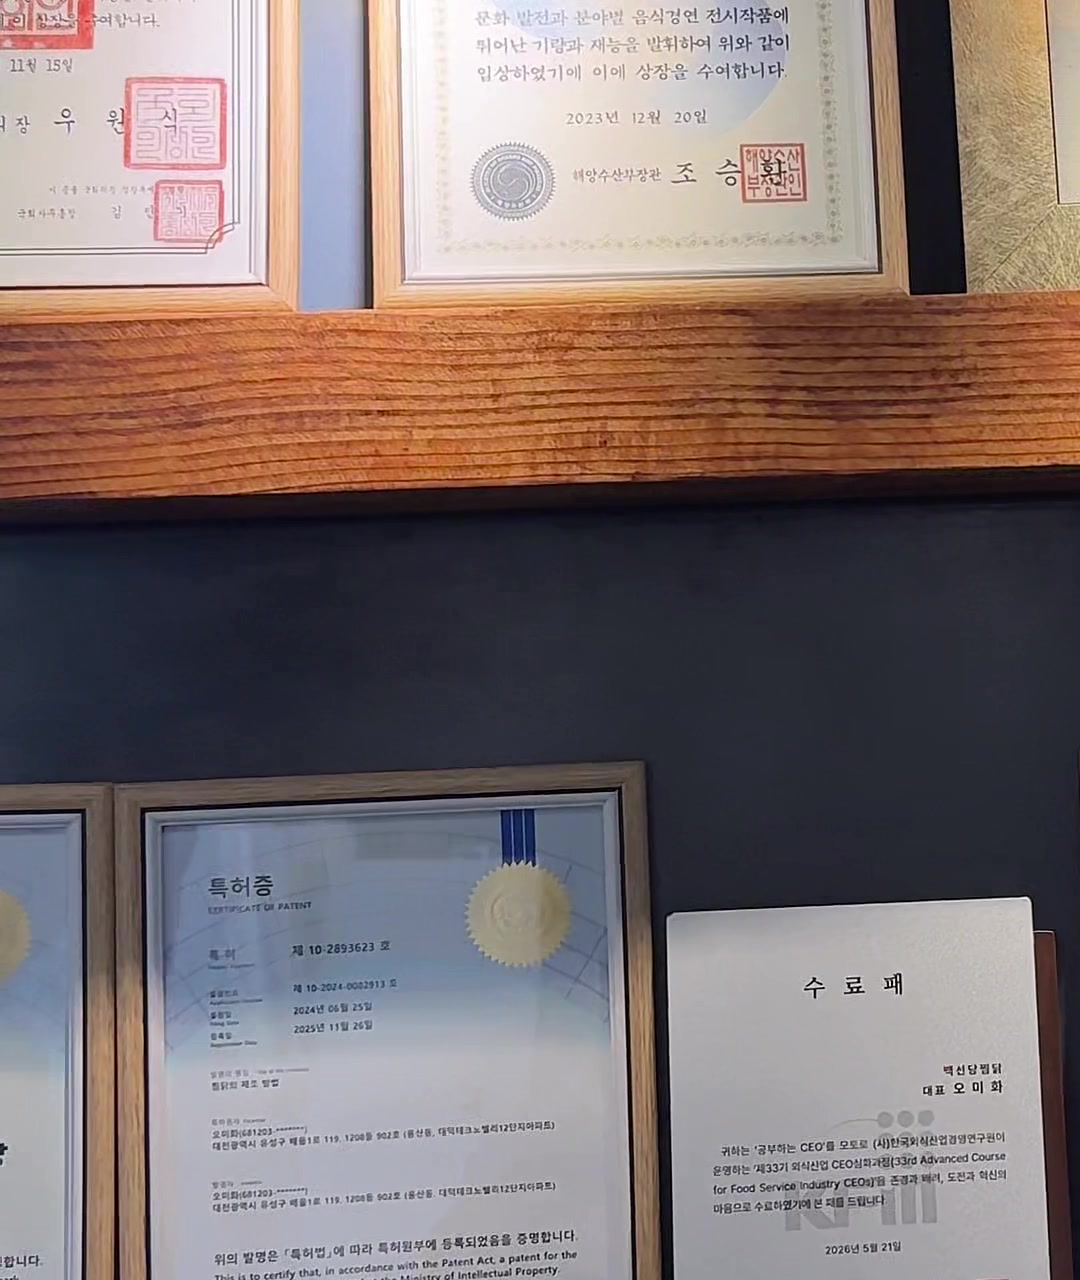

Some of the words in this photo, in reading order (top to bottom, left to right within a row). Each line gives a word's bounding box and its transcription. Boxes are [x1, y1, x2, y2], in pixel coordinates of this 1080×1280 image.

[474, 9, 510, 27] 문화
[517, 9, 568, 27] 발전과
[632, 8, 698, 26] 음식경연
[705, 6, 789, 25] 전시작품에
[476, 37, 527, 55] 뛰어난
[647, 35, 711, 53] 발휘하여
[719, 35, 752, 52] 위와
[758, 34, 790, 52] 같이
[477, 64, 582, 82] 입상하였기에
[592, 64, 626, 81] 이에
[636, 63, 688, 81] 상장을
[697, 62, 787, 80] 수여합니다.
[566, 111, 620, 125] 2023년
[632, 110, 661, 125] 12월
[674, 109, 707, 125] 20일
[572, 169, 662, 183] 해양수산부장관
[208, 873, 274, 899] 특허증
[923, 1084, 946, 1096] 대표
[920, 1153, 968, 1165] Advanced
[971, 1152, 1006, 1162] Course
[713, 1184, 727, 1194] for
[731, 1184, 755, 1194] Food
[760, 1182, 796, 1192] Service
[800, 1179, 841, 1191] Industry
[243, 1250, 279, 1265] 발명은
[350, 1243, 373, 1256] 따라
[441, 1233, 512, 1251] 등록되었음을
[517, 1229, 578, 1246] 증명합니다.
[0, 1254, 43, 1268] 합니다.
[250, 1272, 260, 1280] to
[325, 1266, 335, 1275] in
[338, 1263, 394, 1275] accordance
[397, 1260, 419, 1270] with
[422, 1259, 438, 1269] the
[442, 1256, 473, 1267] Patent
[508, 1253, 541, 1267] patent
[543, 1251, 558, 1261] for
[561, 1250, 578, 1260] the
[444, 1271, 455, 1280] of
[458, 1267, 512, 1280] Intellectual
